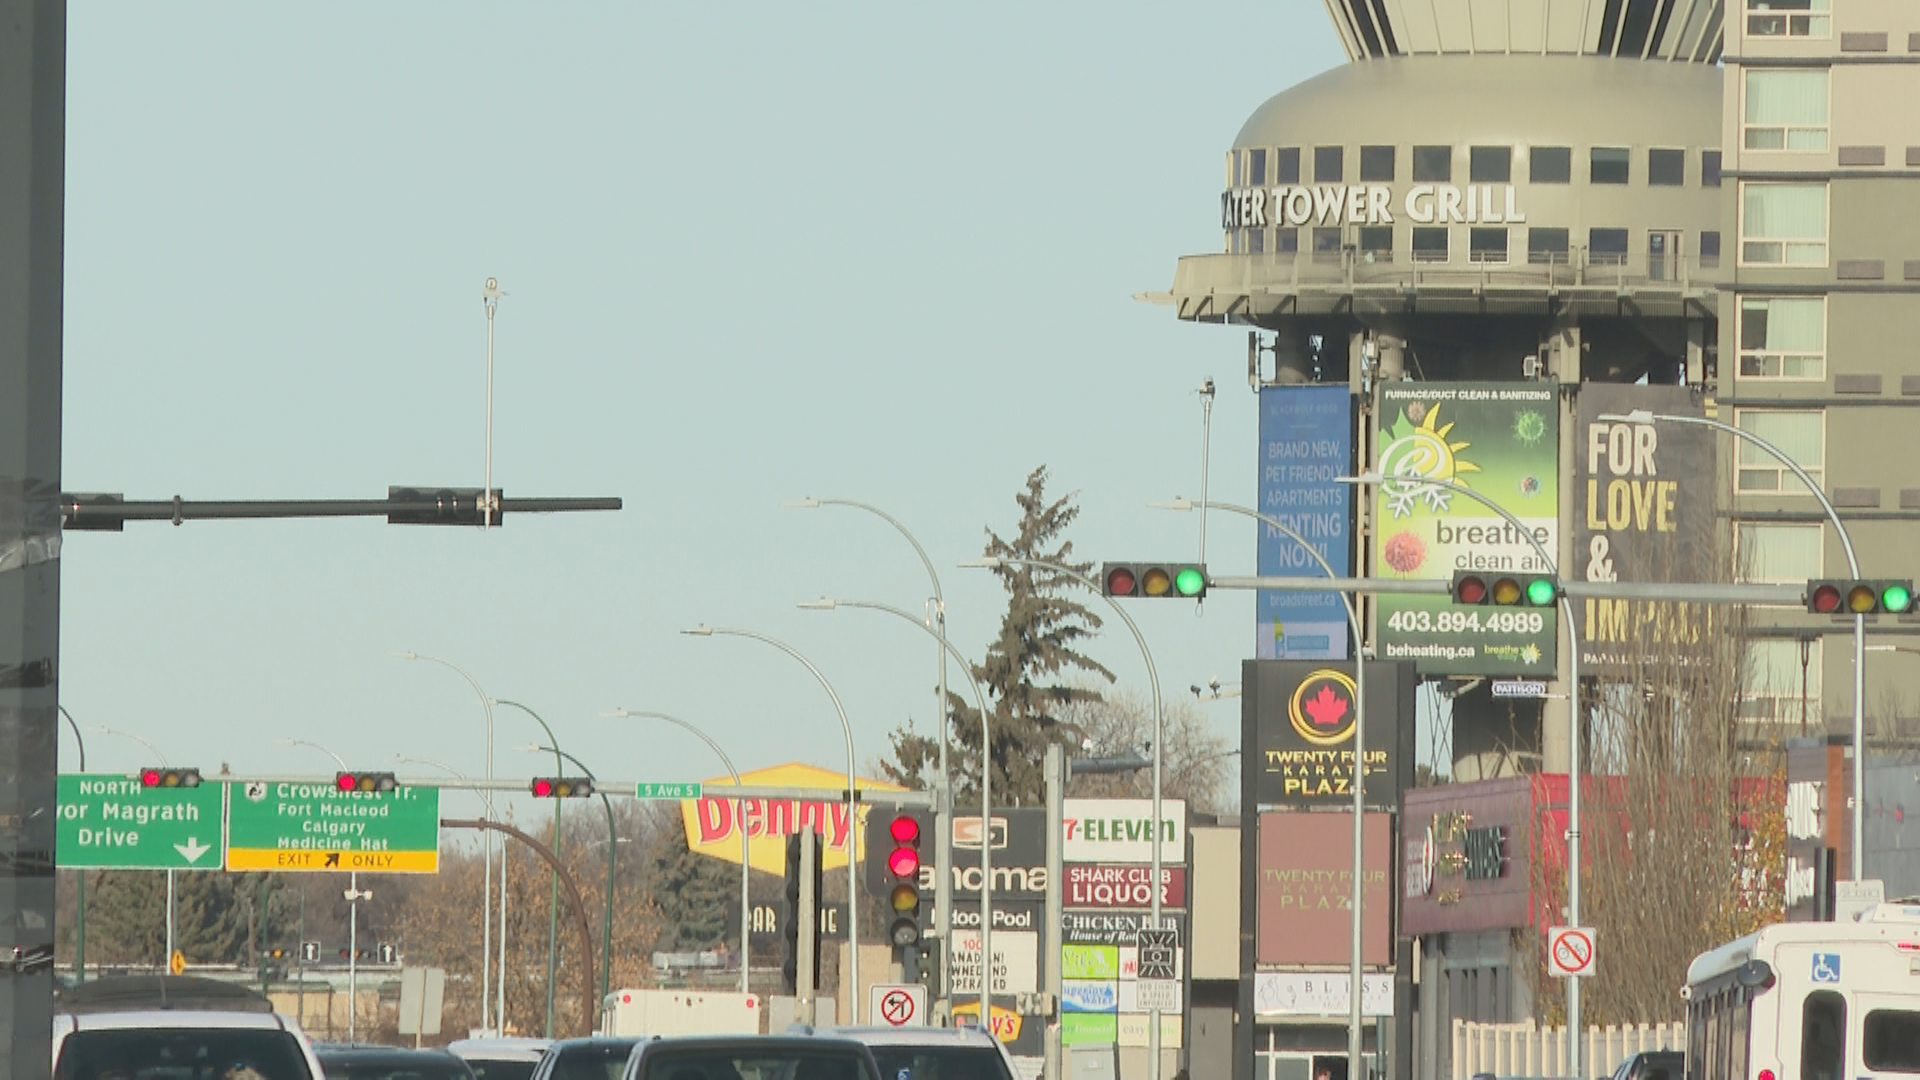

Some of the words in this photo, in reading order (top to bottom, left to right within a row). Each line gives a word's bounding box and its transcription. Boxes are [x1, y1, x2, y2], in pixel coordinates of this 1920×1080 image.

[1271, 185, 1395, 226] TOWER
[1404, 184, 1527, 224] GRILL
[1385, 390, 1457, 401] FURNACE/DUCT
[1458, 390, 1490, 400] CLEAN
[1490, 390, 1499, 400] &
[1500, 390, 1551, 401] SANITIZING
[1268, 441, 1309, 459] BRAND
[1312, 440, 1341, 459] NEW,
[1588, 423, 1658, 476] FOR
[1265, 466, 1286, 483] PET
[1289, 464, 1344, 482] FRIENDLY
[1266, 488, 1342, 507] APARTMENTS
[1587, 478, 1678, 532] LOVE
[1266, 513, 1342, 538] RENTING
[1437, 519, 1549, 544] breathe
[1455, 551, 1513, 569] clean
[1586, 534, 1618, 583] &
[1270, 592, 1336, 607] broadstreet.ca
[1387, 611, 1543, 633] 403.894.4989
[1386, 643, 1476, 660] beheating.ca
[1495, 683, 1542, 694] PATTISON
[1265, 751, 1337, 763] TWENTY
[79, 781, 142, 795] NORTH
[657, 784, 682, 797] Ave
[686, 785, 694, 796] S
[1284, 779, 1367, 795] PLAZ
[102, 802, 199, 825] Magrath
[277, 802, 312, 816] Fort
[320, 803, 389, 817] Macleod
[78, 827, 139, 846] Drive
[302, 820, 366, 837] Calgary
[277, 836, 351, 850] Medicine
[360, 838, 389, 850] Hat
[277, 853, 312, 866] EXIT
[352, 854, 394, 867] ONLY
[1070, 868, 1125, 883] SHARK
[1264, 869, 1336, 882] TWENTY
[1280, 895, 1368, 910] PLAZ
[748, 906, 777, 933] AR
[993, 909, 1031, 927] Pool
[1062, 914, 1136, 930] CHICKEN
[1070, 930, 1101, 941] House
[1103, 931, 1117, 944] of
